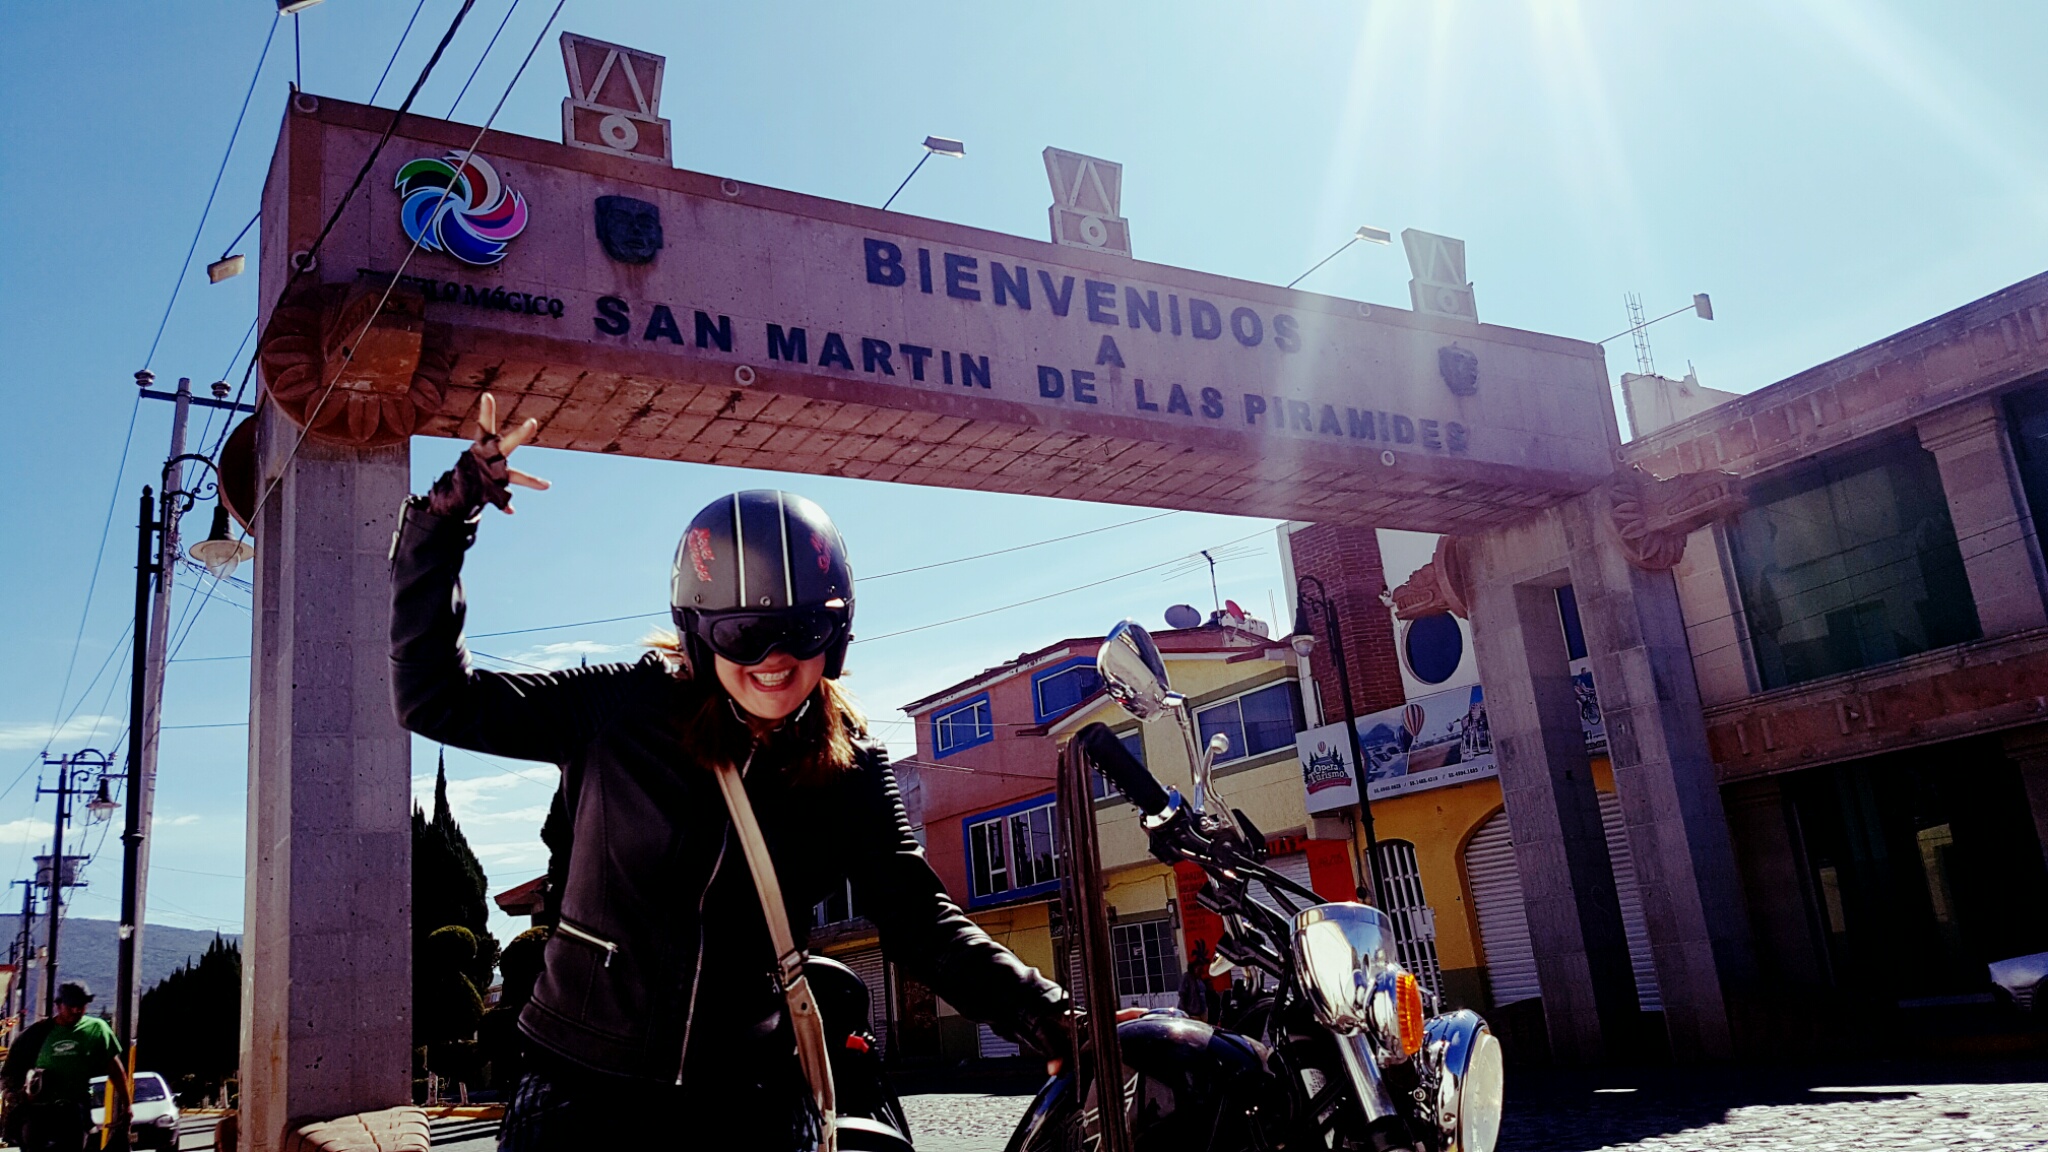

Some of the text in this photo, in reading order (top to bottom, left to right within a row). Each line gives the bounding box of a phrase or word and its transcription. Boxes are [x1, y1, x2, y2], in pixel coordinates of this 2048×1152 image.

[864, 237, 1302, 353] BIENVENIDOS
[595, 296, 992, 389] SAN MARTIN
[1095, 335, 1126, 369] A
[1038, 366, 1468, 452] DE LAS PIRAMIDES
[1307, 770, 1345, 783] Turismo
[1313, 763, 1338, 775] Opera
